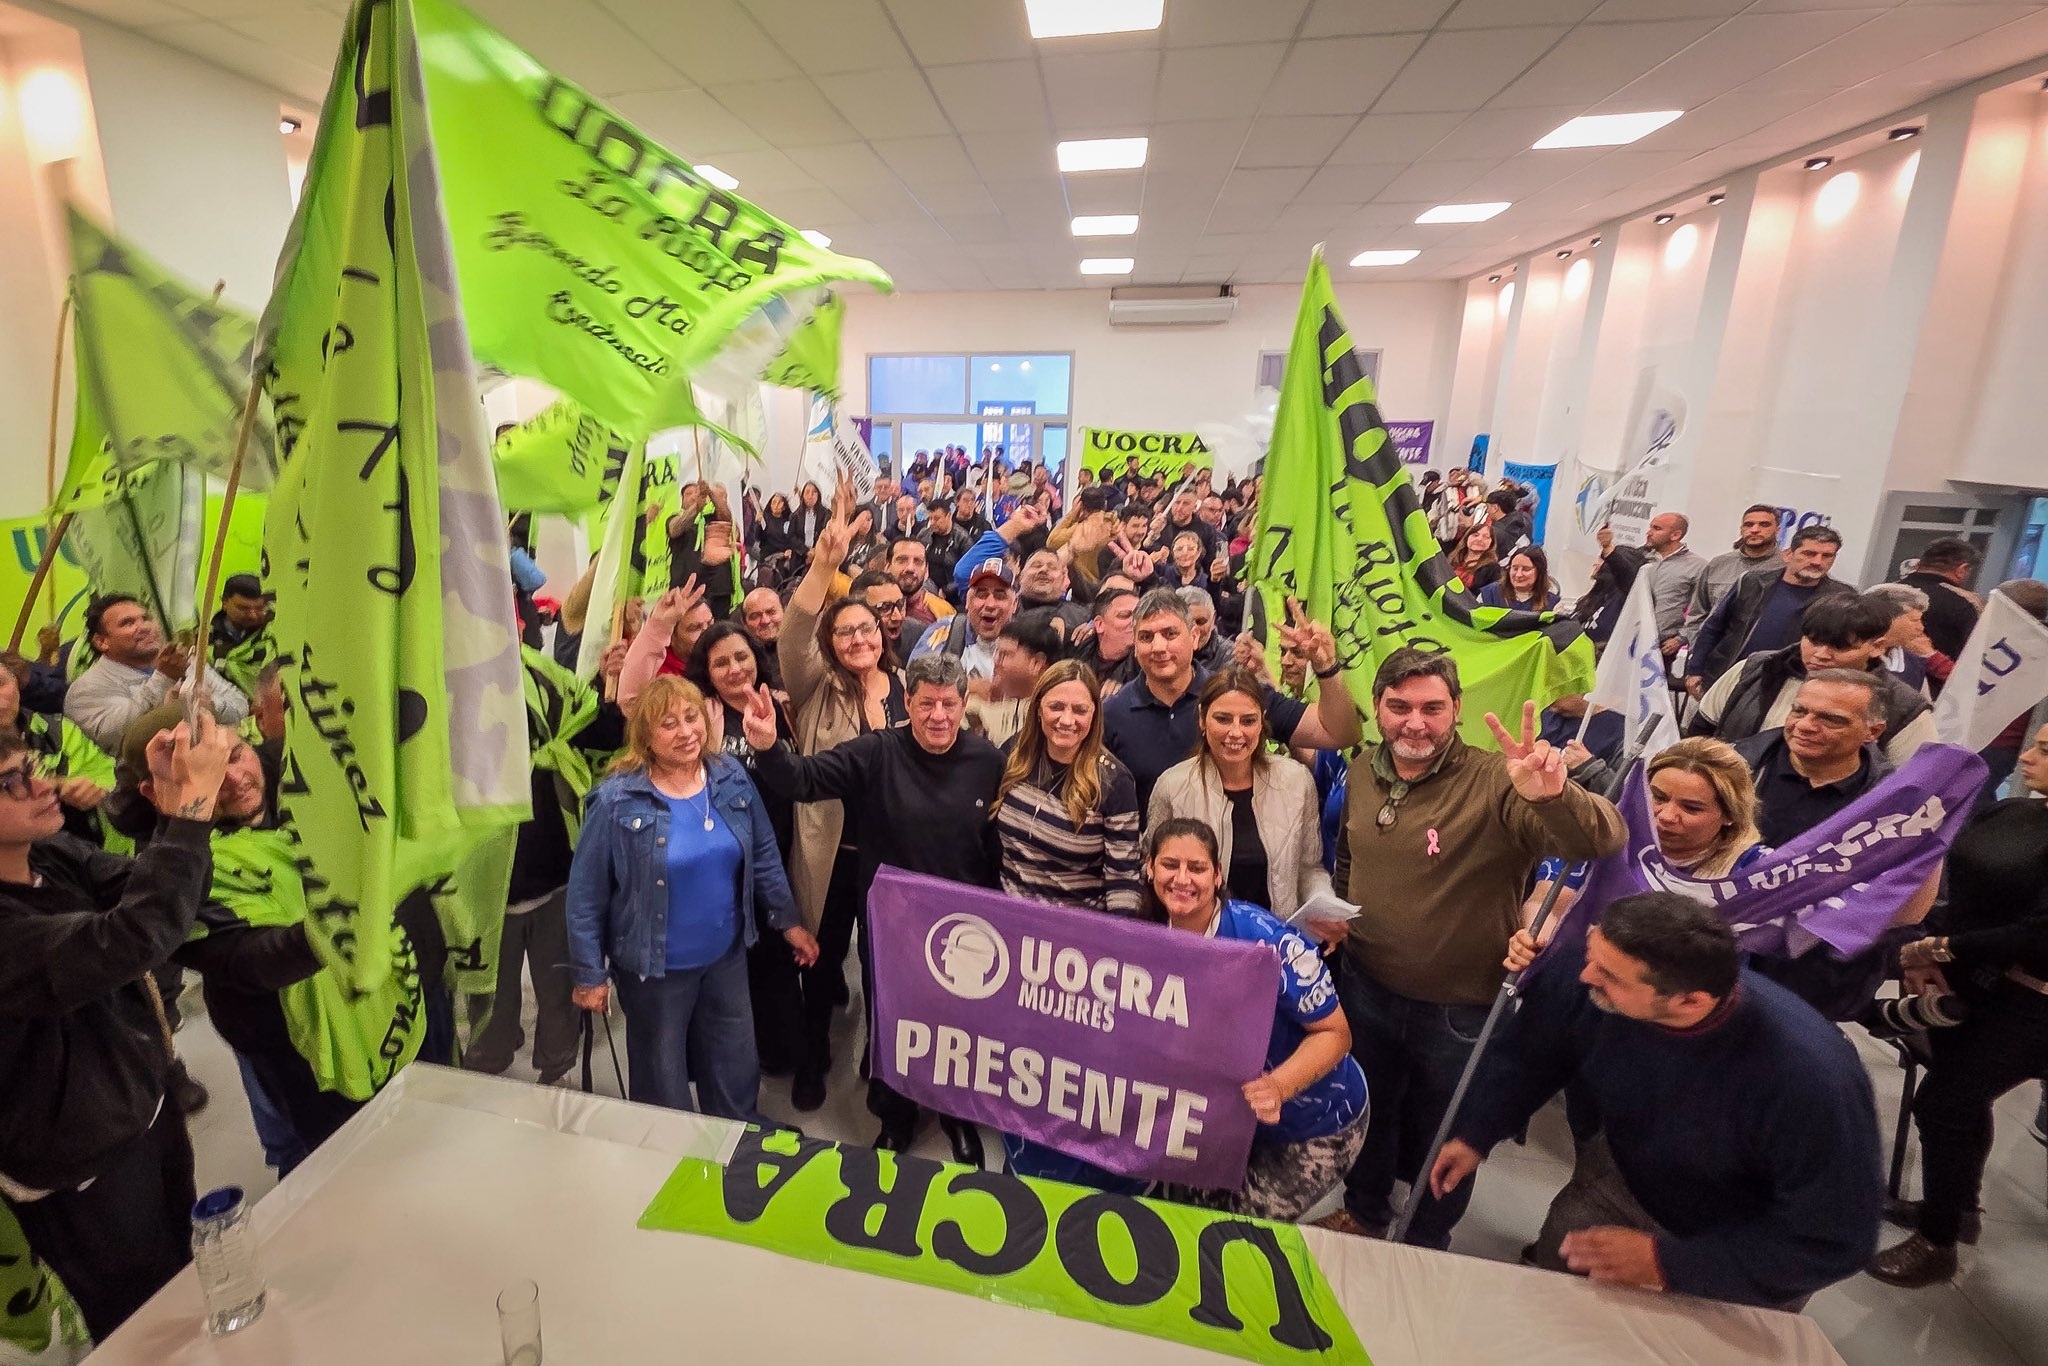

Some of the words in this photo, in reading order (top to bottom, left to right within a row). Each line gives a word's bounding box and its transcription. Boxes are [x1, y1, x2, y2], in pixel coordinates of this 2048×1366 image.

[1092, 431, 1210, 454] UOCRA
[1017, 981, 1116, 1033] MUJERES
[1019, 935, 1190, 1028] UOCRA
[895, 1018, 1209, 1161] PRESENTE
[721, 1126, 1333, 1353] UOCRA
